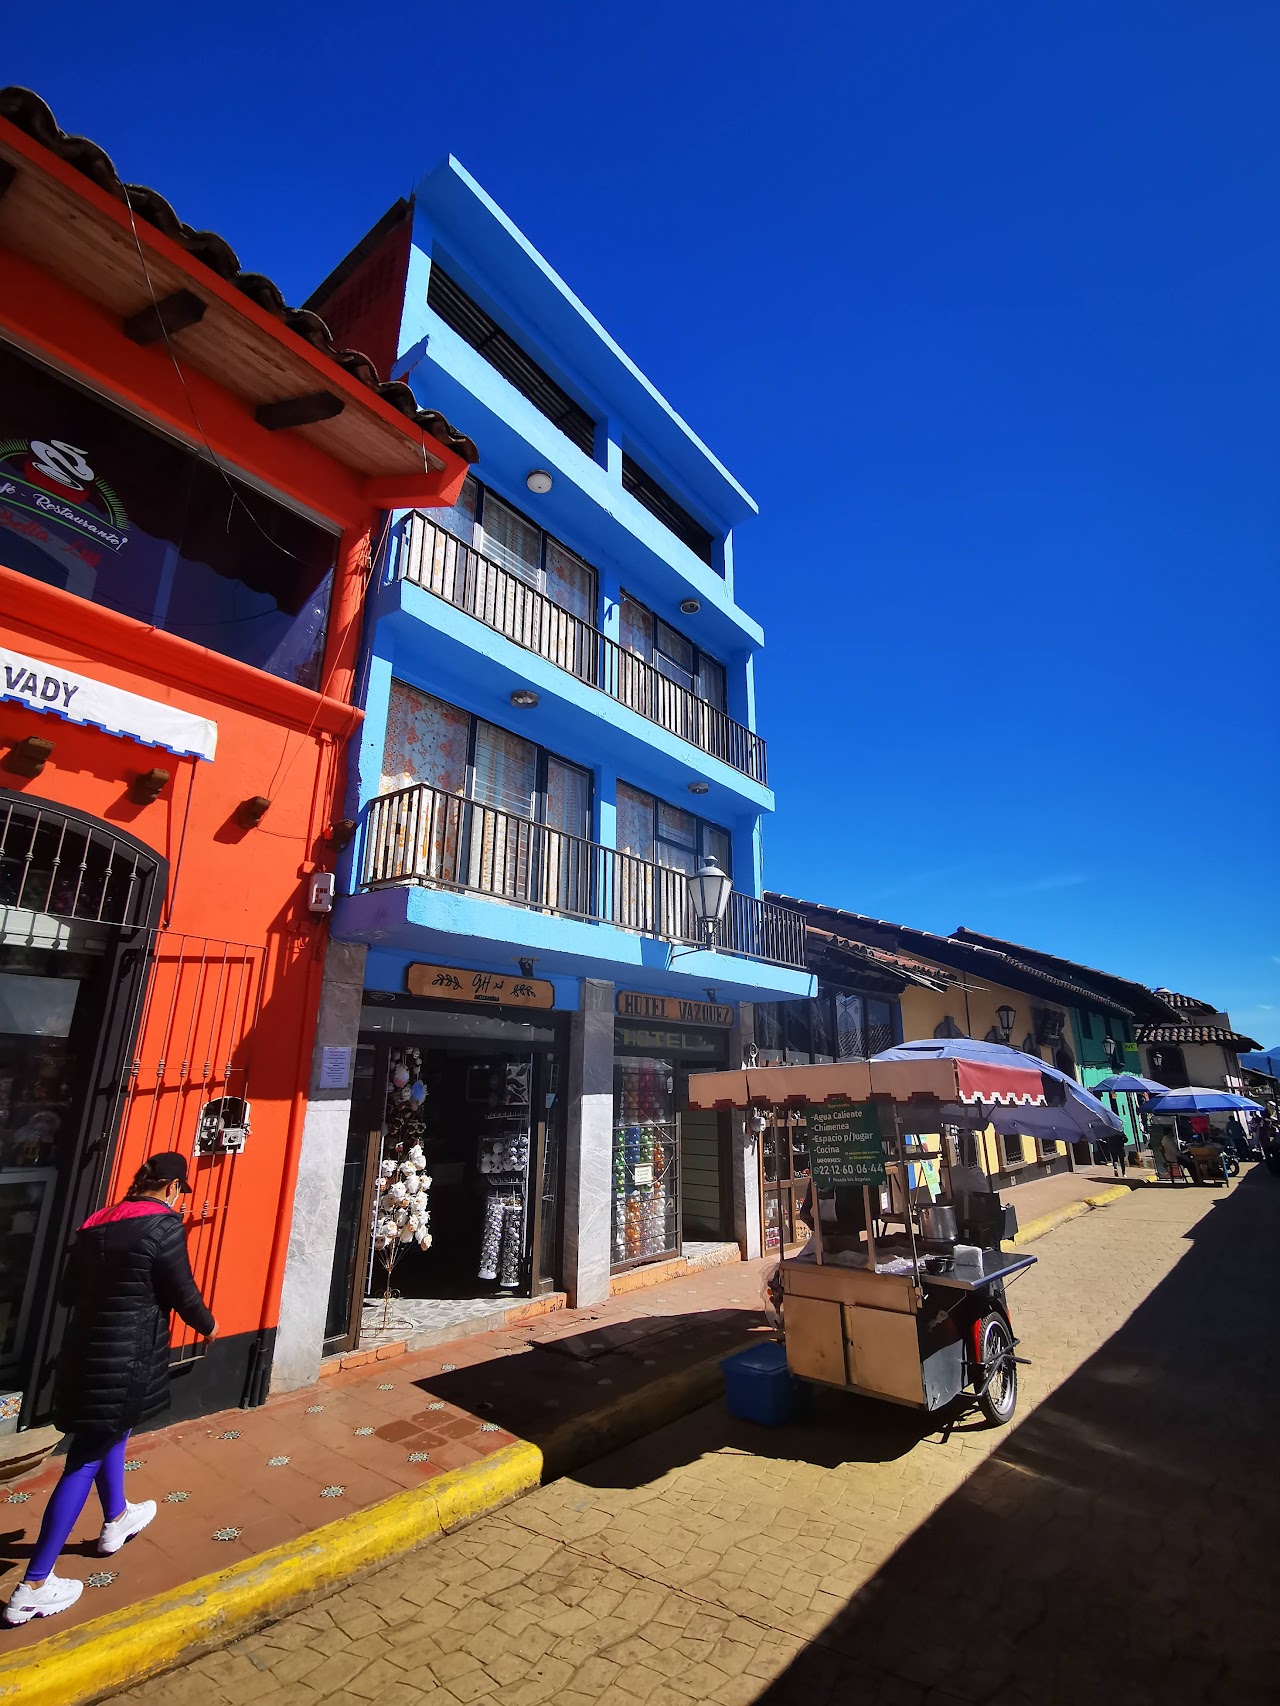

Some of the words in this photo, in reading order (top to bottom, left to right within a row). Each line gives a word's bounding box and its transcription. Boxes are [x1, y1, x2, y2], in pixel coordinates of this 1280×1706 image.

[4, 666, 80, 708] VADY
[623, 993, 669, 1018] HOTEL
[678, 1001, 730, 1023] VAZQUEZ
[623, 1029, 696, 1049] HOTEL
[811, 1113, 832, 1123] -Agua
[833, 1110, 863, 1120] Caliente
[811, 1123, 850, 1132] -Chimenea
[812, 1132, 843, 1144] -Espacio
[843, 1131, 873, 1143] p/Jugar
[814, 1145, 840, 1154] -Cocina
